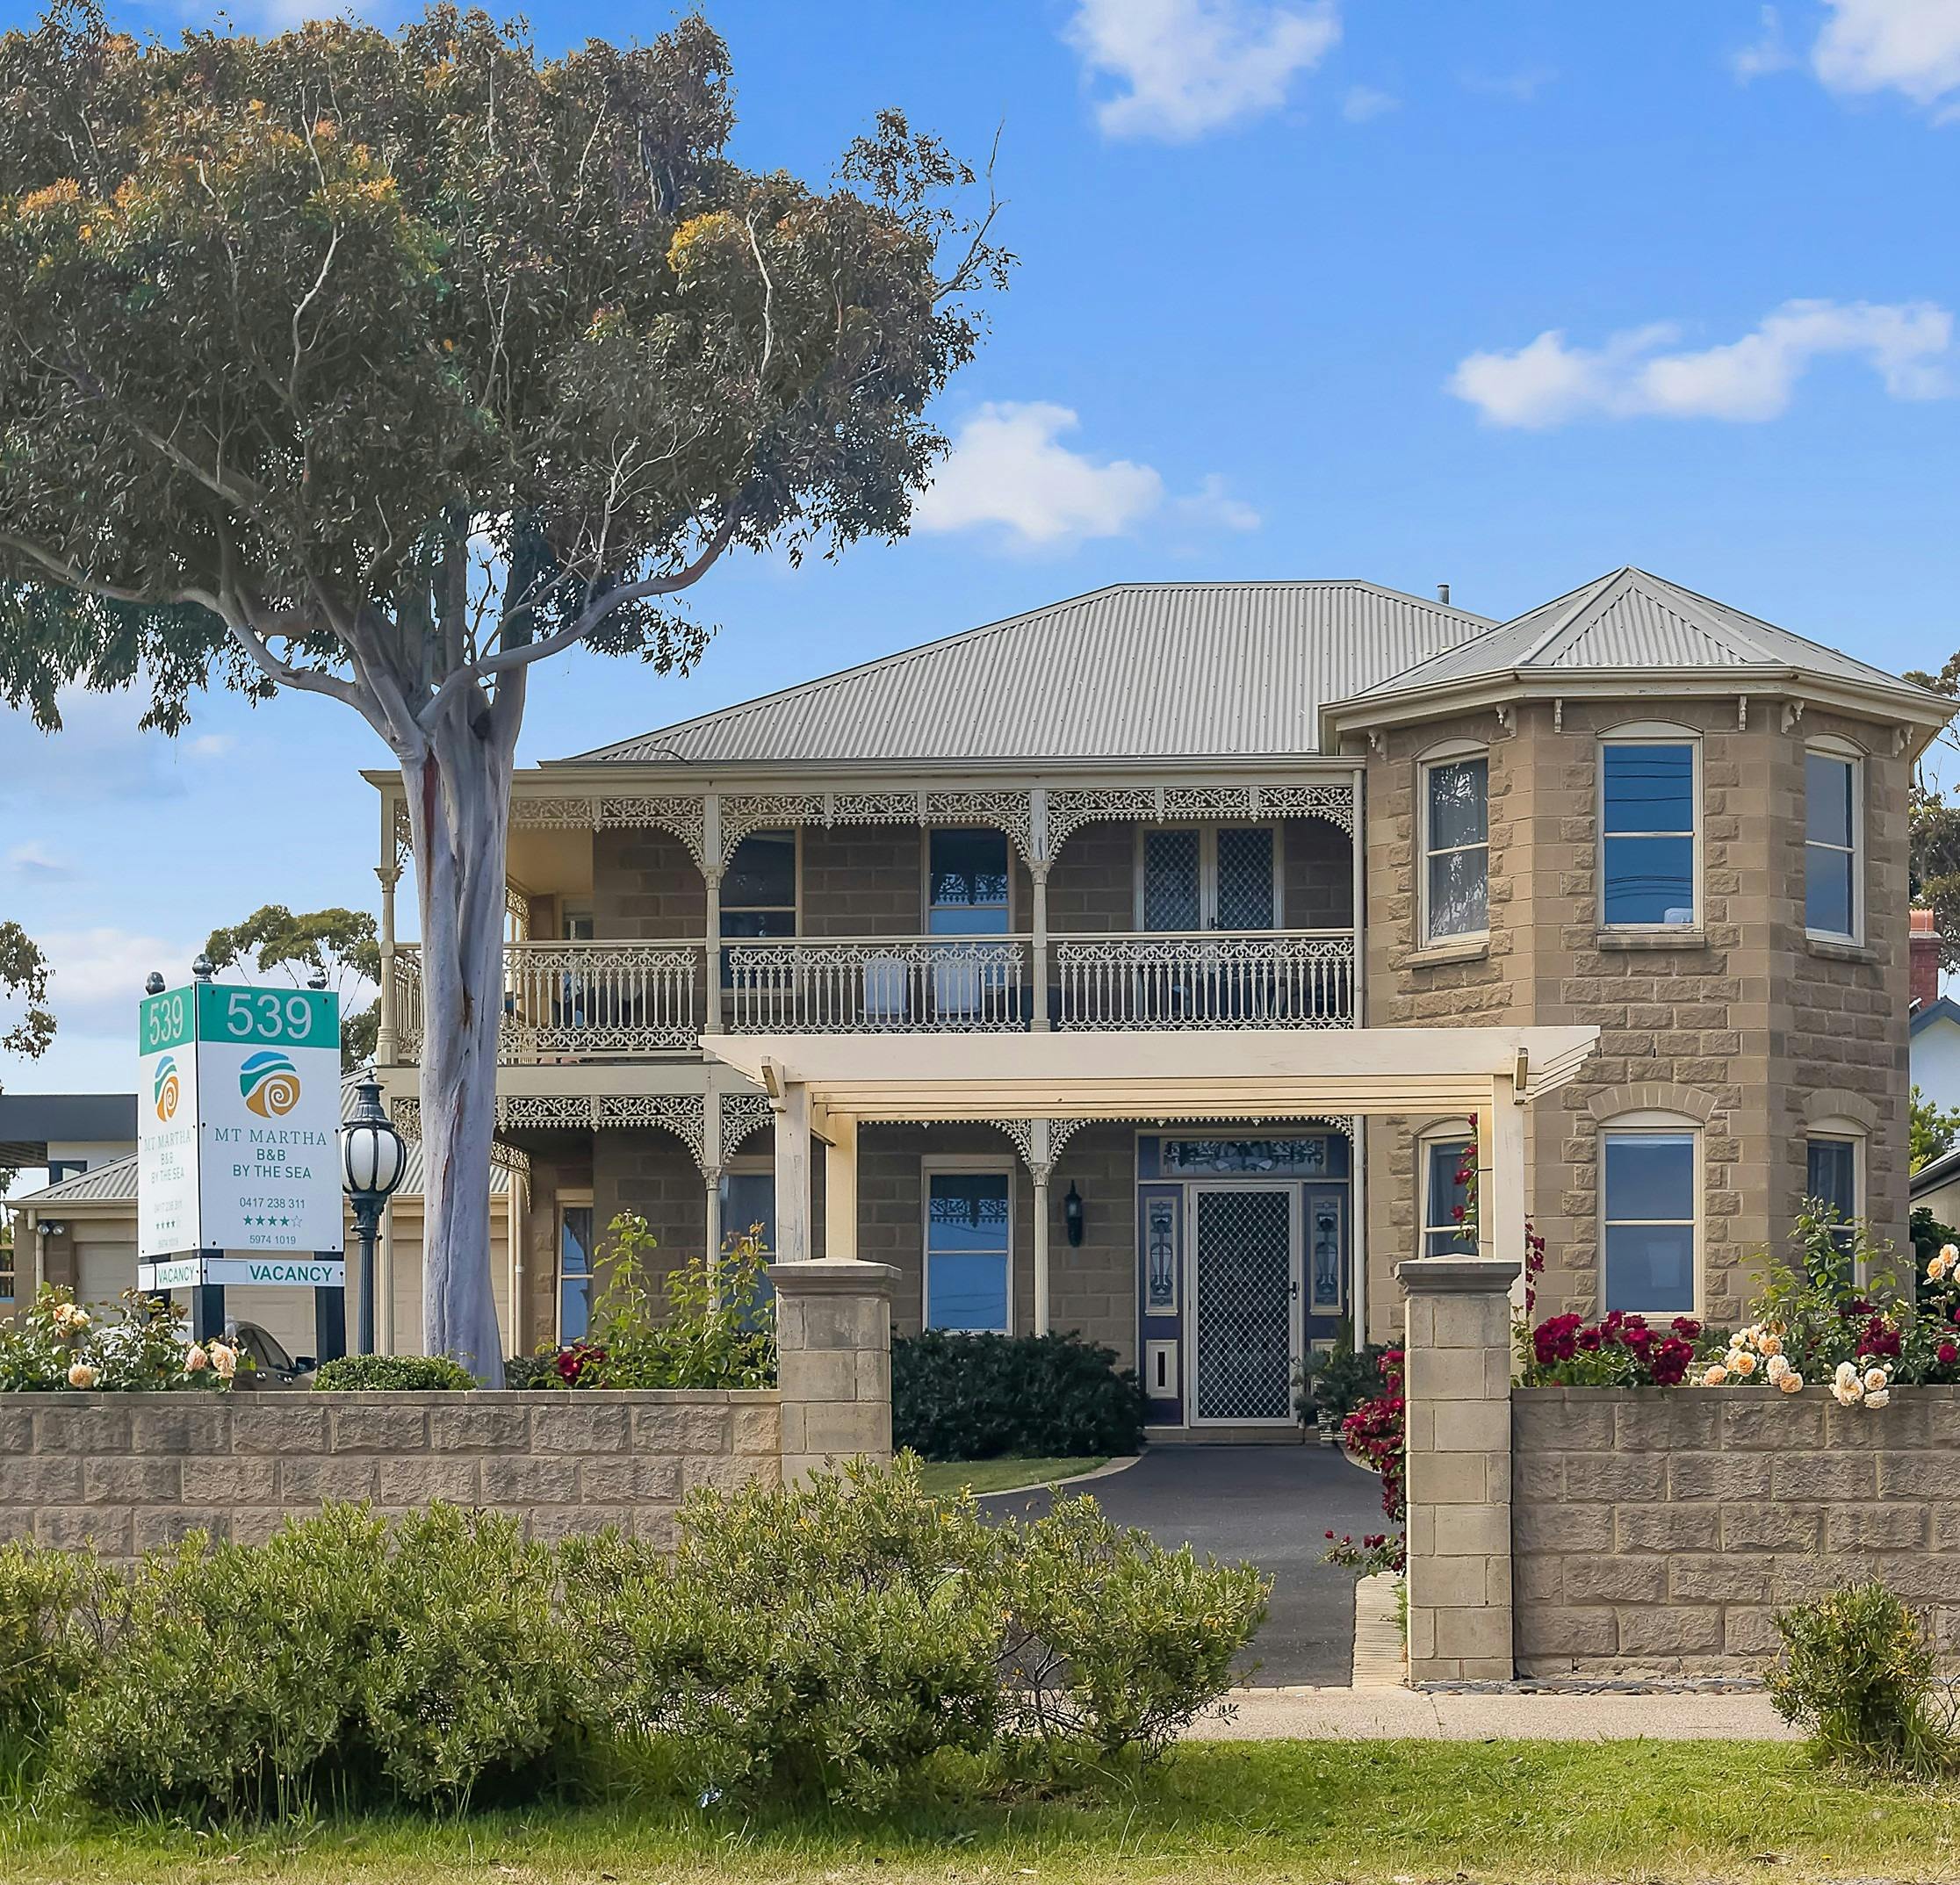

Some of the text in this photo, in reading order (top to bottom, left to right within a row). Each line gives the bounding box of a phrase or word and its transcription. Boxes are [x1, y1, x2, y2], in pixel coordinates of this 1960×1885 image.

[149, 995, 184, 1046] 539
[227, 993, 313, 1040] 539
[214, 1127, 328, 1146] MT MARTHA
[256, 1148, 286, 1162] B&B
[233, 1164, 312, 1179] BY THE SEA
[239, 1197, 306, 1209] 0417 238 311
[249, 1235, 296, 1245] 5974 1019
[158, 1266, 194, 1284] VACANCY
[249, 1265, 333, 1282] VACANCY
